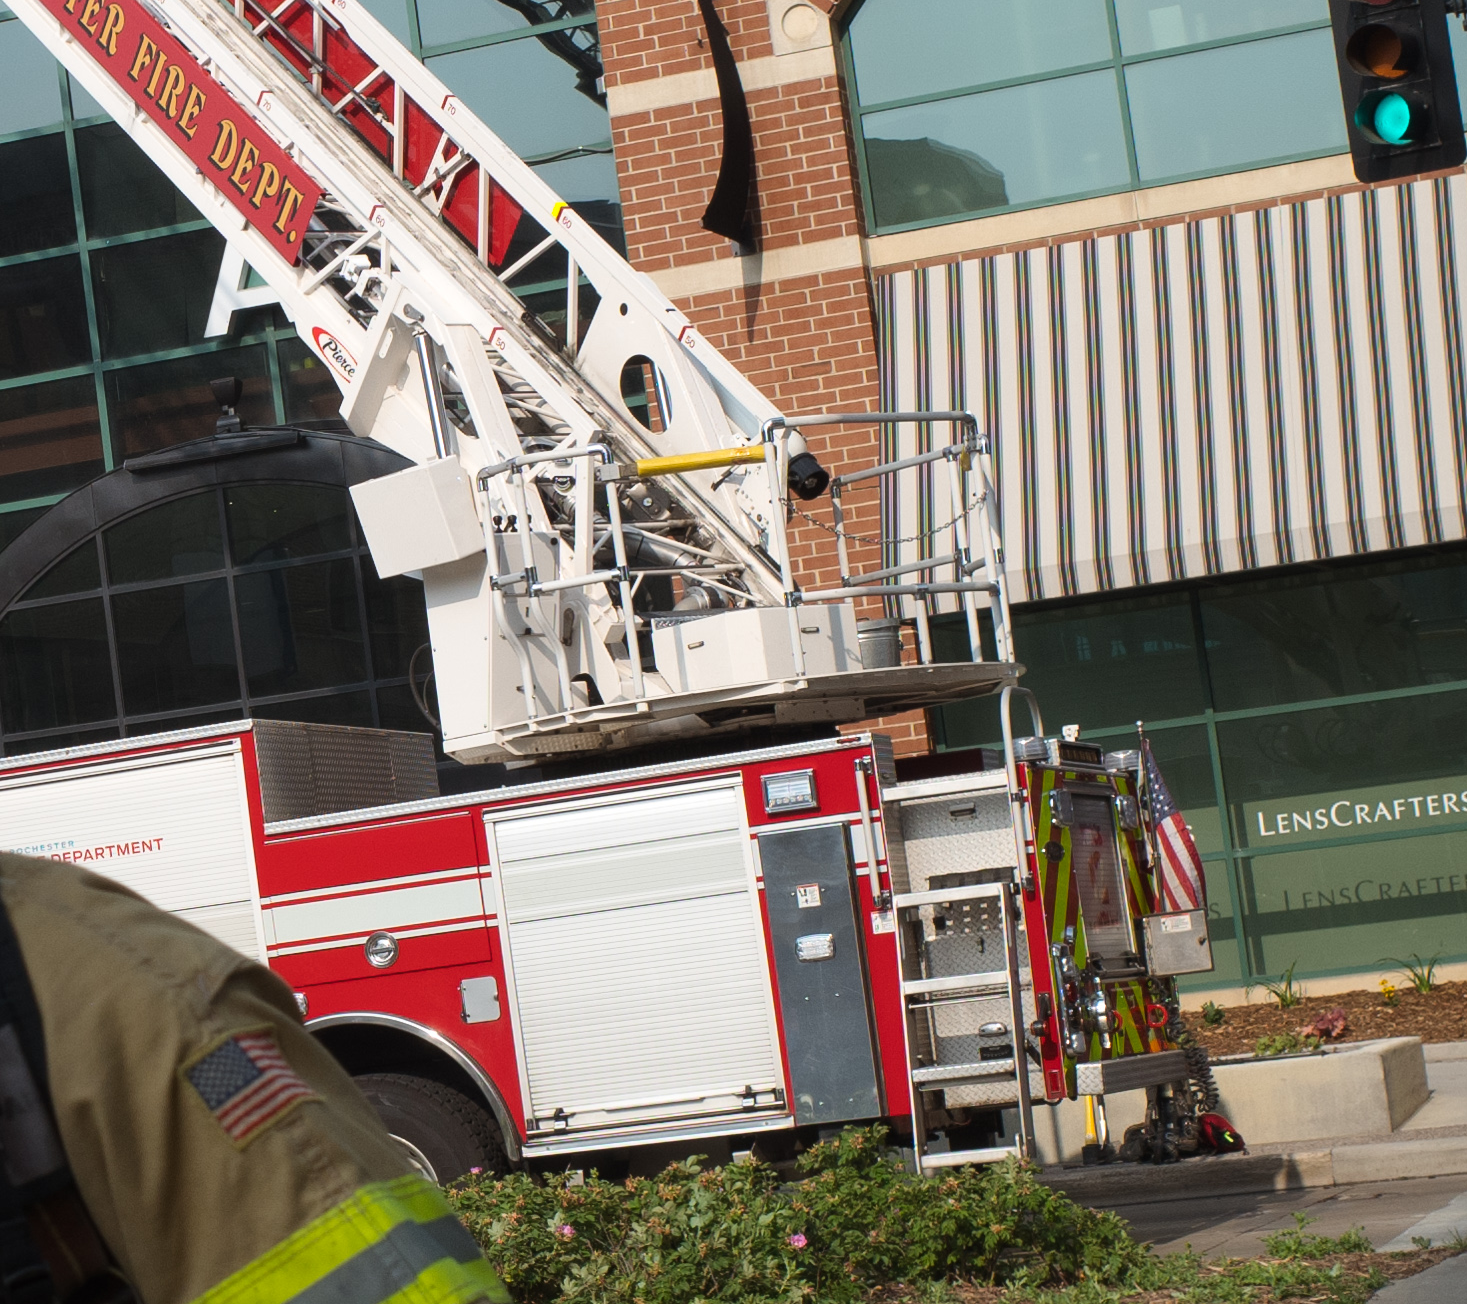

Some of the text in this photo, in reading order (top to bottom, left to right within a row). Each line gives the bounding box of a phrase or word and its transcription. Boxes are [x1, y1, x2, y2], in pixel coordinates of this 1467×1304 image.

[128, 33, 207, 141] FIRE
[208, 118, 306, 244] DEPT.
[322, 337, 356, 378] Pierce
[50, 837, 164, 864] DEPARTMENT
